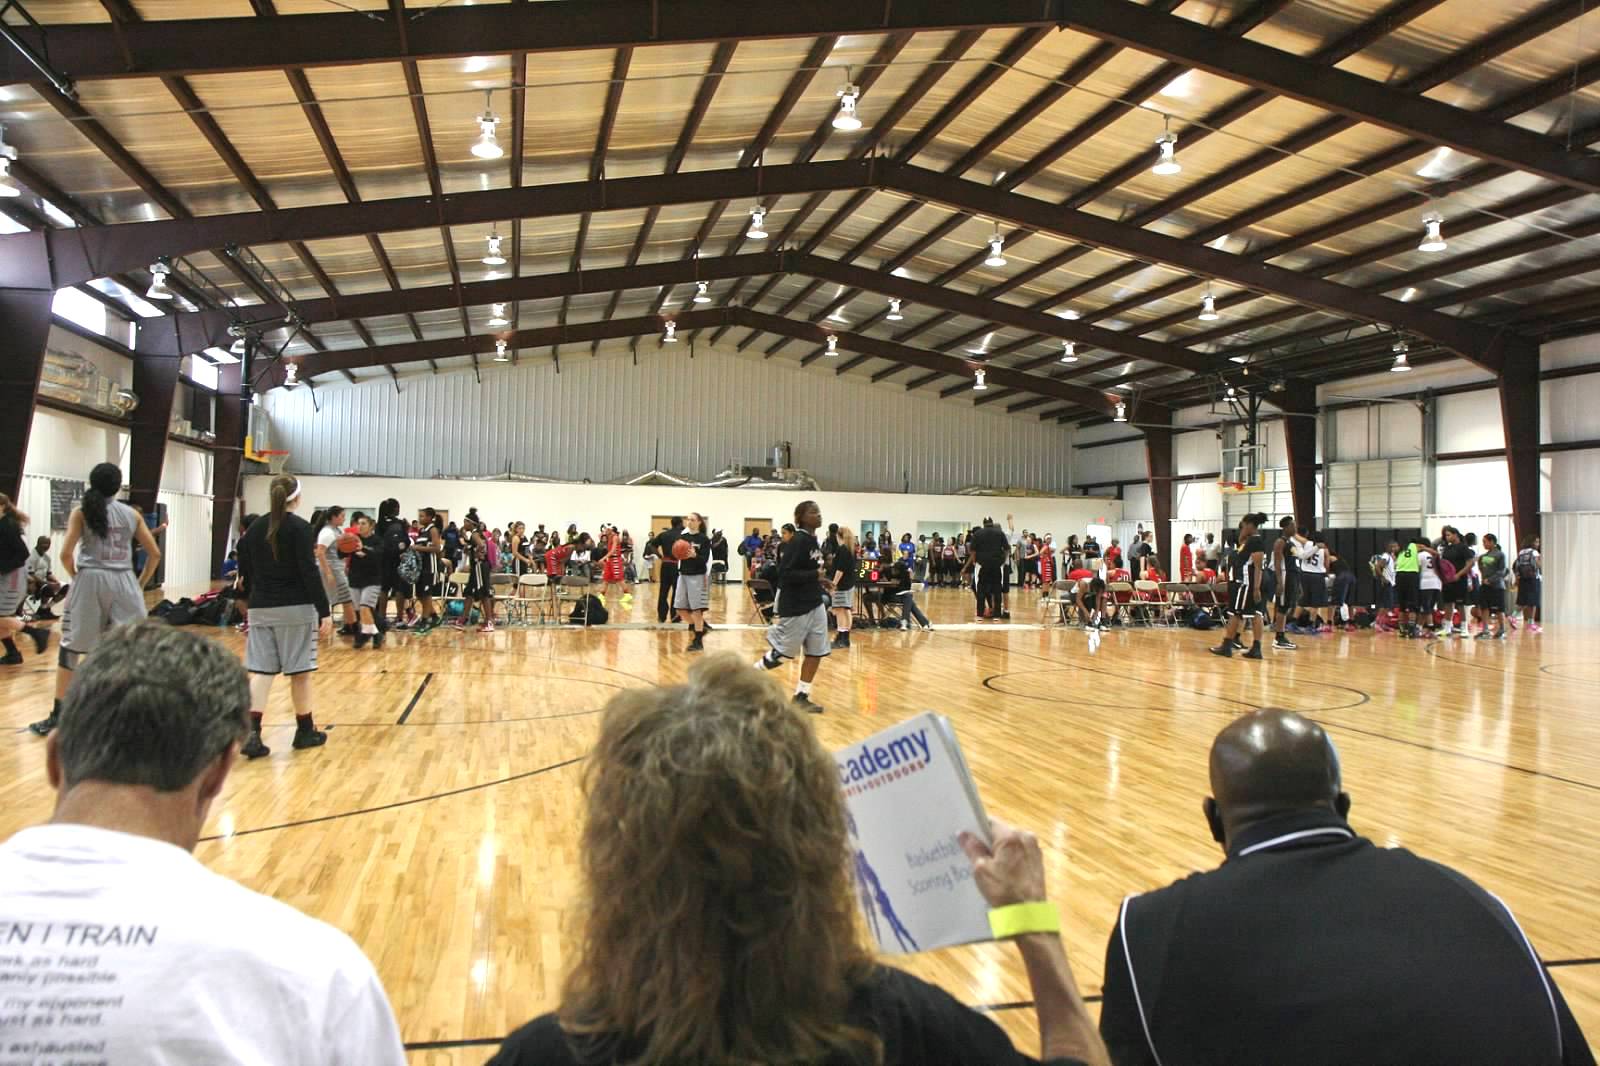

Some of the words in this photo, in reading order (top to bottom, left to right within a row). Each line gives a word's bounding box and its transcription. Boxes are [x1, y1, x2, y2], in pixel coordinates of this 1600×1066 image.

[837, 729, 931, 785] cademy
[42, 923, 53, 945] I
[64, 924, 158, 947] TRAIN
